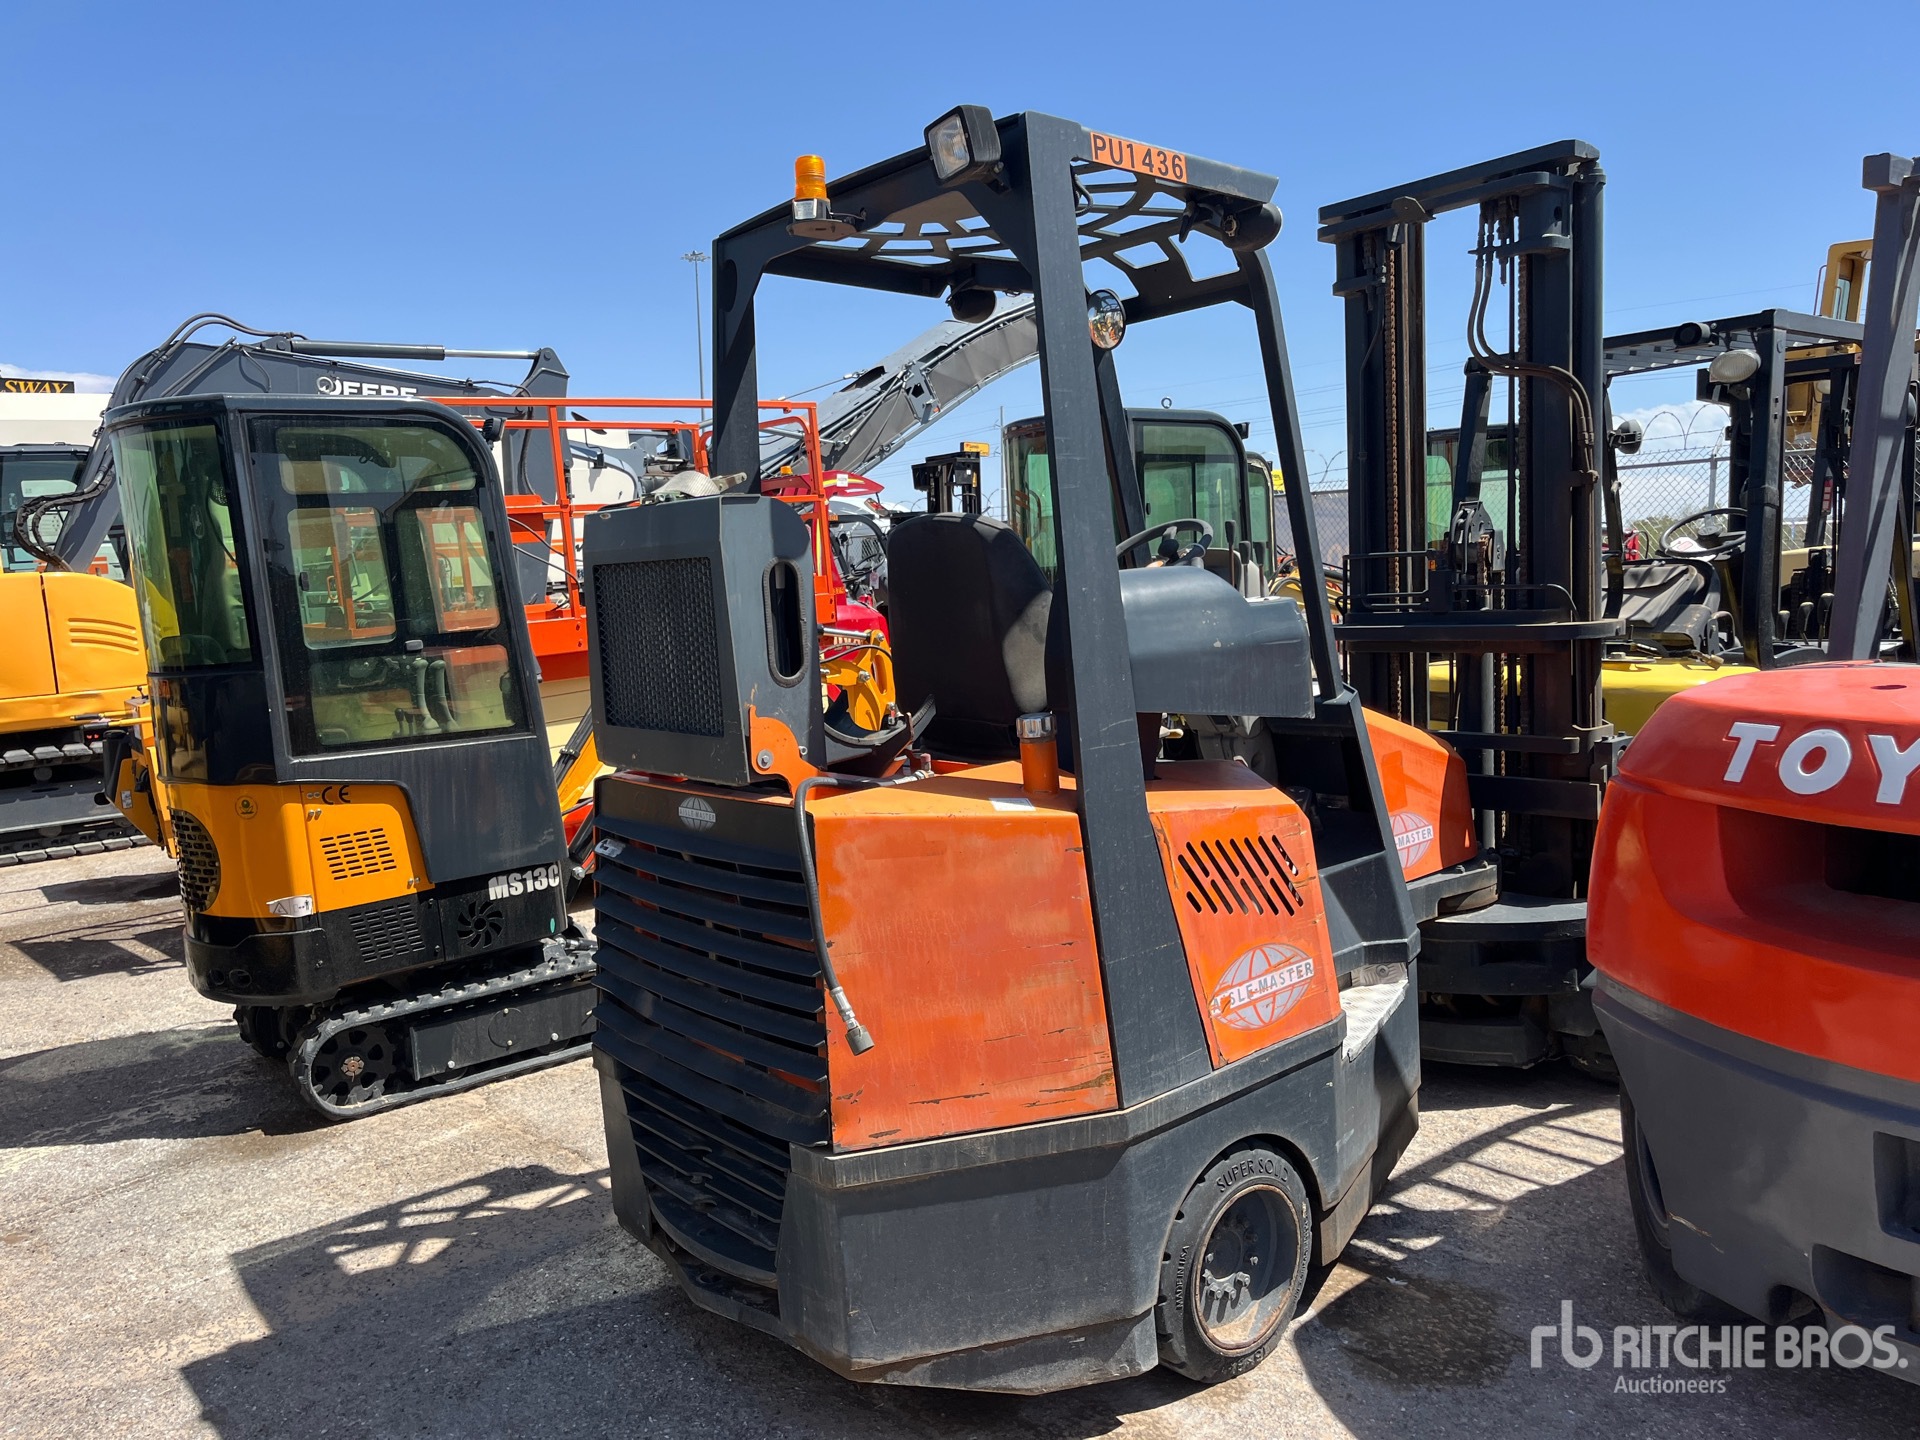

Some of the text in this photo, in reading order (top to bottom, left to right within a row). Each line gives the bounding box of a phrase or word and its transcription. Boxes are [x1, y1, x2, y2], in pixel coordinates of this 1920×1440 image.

[1092, 133, 1184, 180] PU1436
[488, 864, 560, 900] MS13C
[1211, 962, 1314, 1014] ASLE-MASTER
[1216, 1158, 1255, 1193] SUPER
